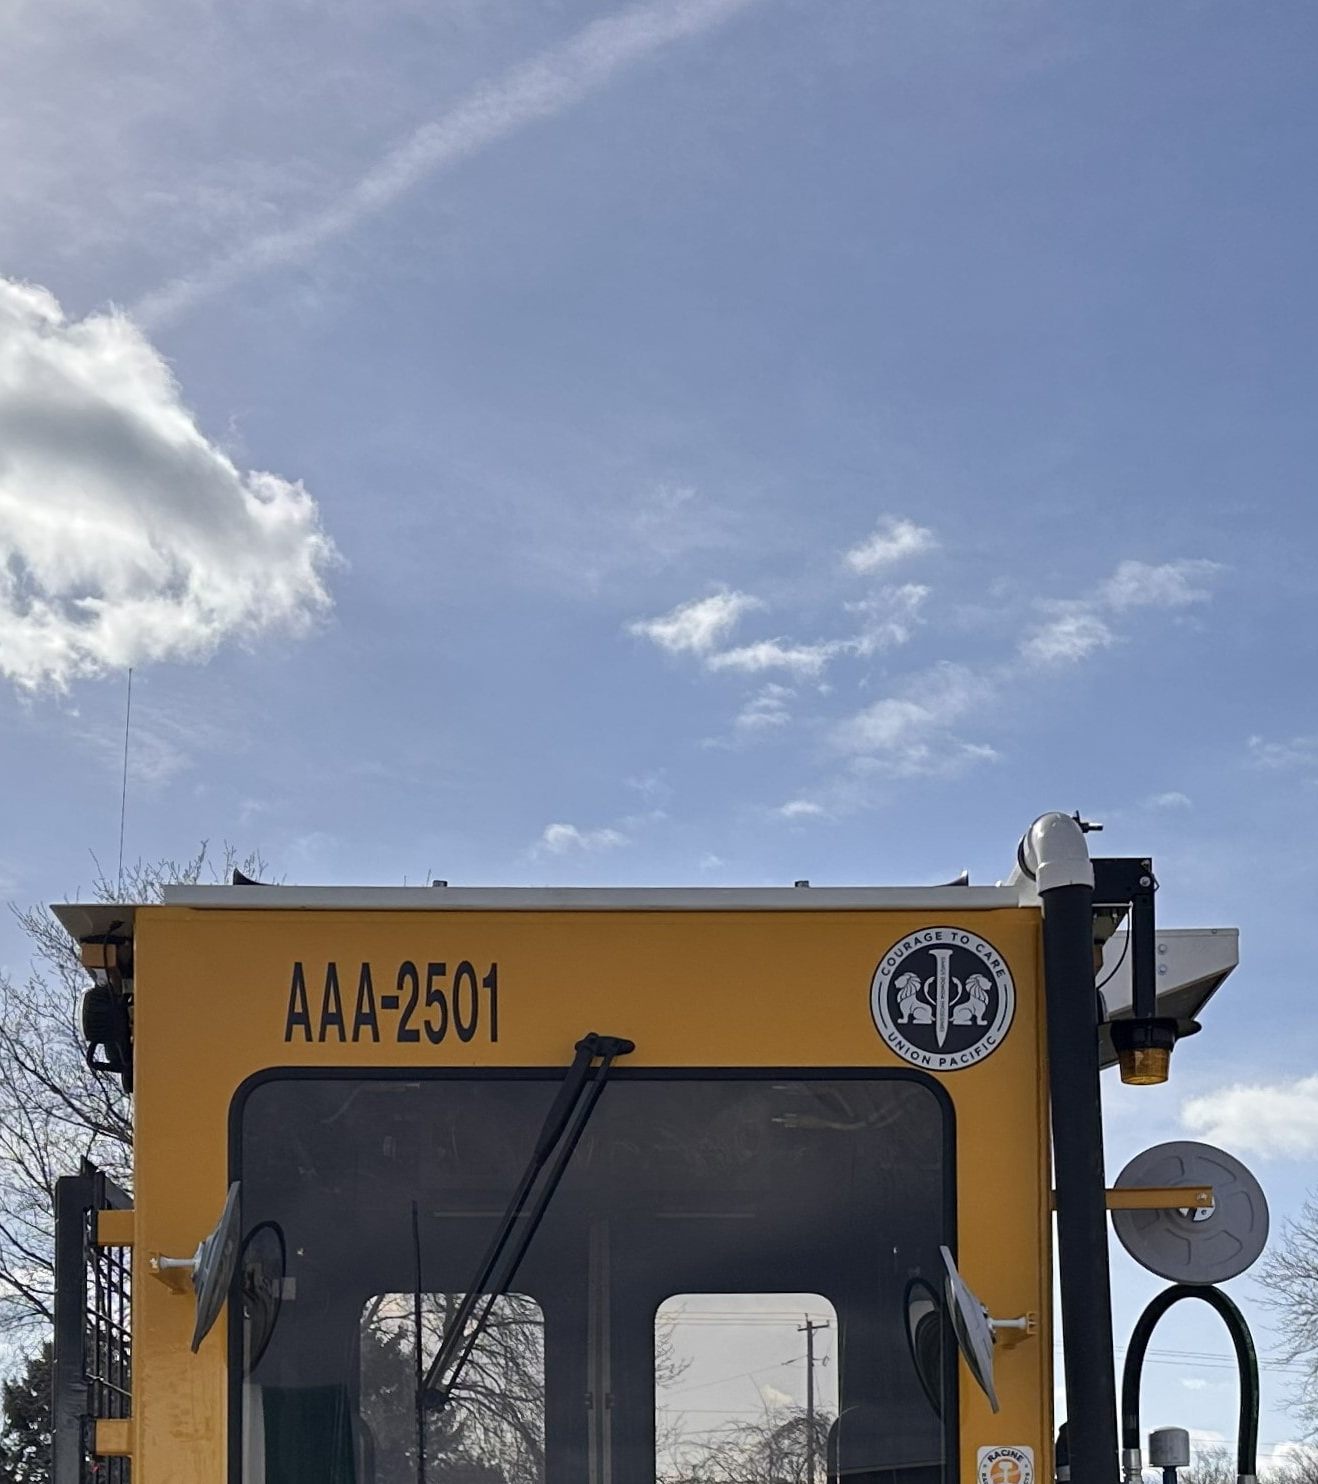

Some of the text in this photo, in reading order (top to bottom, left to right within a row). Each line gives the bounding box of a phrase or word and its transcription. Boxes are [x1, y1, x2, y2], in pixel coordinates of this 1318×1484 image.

[882, 931, 1006, 978] COURAGE TO CARE
[284, 960, 498, 1045] AAA-2501
[888, 1032, 997, 1067] UNION PACIFIC
[987, 1449, 1024, 1462] RACINE
